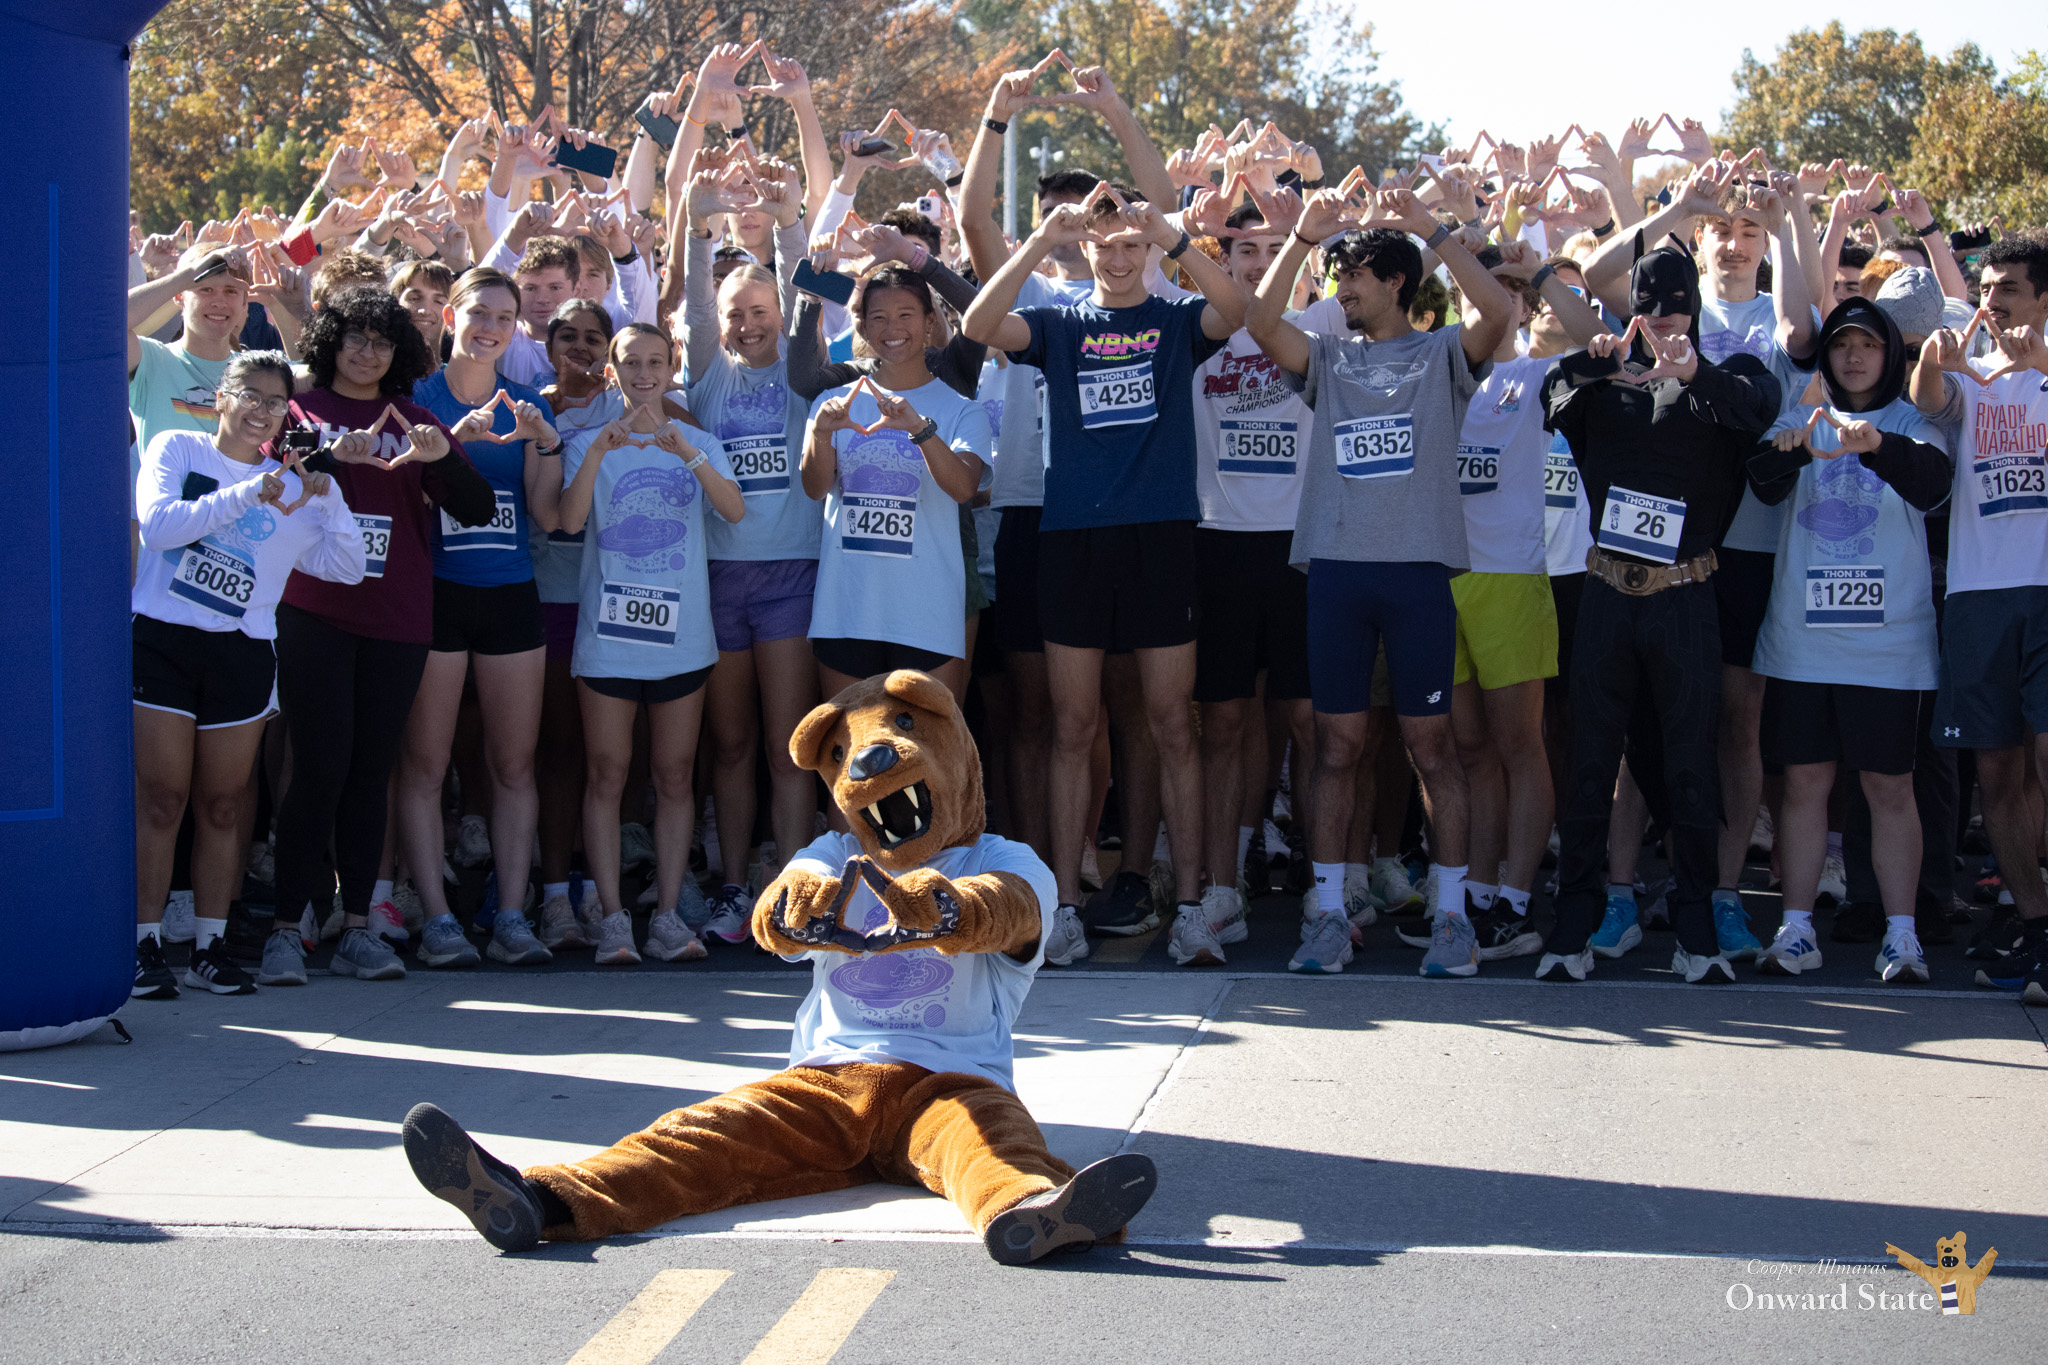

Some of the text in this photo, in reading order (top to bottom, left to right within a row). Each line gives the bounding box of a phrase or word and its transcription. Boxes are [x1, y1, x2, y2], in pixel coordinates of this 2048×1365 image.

[1080, 328, 1160, 355] NBNO
[1094, 369, 1140, 383] THON 5K
[1098, 378, 1154, 406] 4259
[1225, 389, 1295, 415] CHAMPIONSHIP
[1238, 382, 1286, 404] STATE INDO
[1237, 421, 1282, 431] THON 5K
[1351, 420, 1397, 432] THON 5K
[1976, 402, 2027, 430] RIYADH
[730, 439, 772, 451] THON 5K
[1237, 433, 1296, 458] 5503
[1354, 430, 1412, 459] 6352
[1975, 423, 2047, 455] MARATHO
[732, 450, 787, 477] 2985
[1457, 456, 1498, 479] 766
[1556, 458, 1569, 466] 5K
[1988, 456, 2030, 469] THON 5K
[619, 470, 670, 489] DREAM BEYOND
[628, 478, 675, 489] THE DISTANCE
[1544, 468, 1578, 493] 279
[1993, 469, 2046, 495] 1623
[858, 498, 901, 509] THON 5K
[1624, 494, 1670, 512] THON 5K
[363, 519, 376, 528] 5K
[857, 510, 913, 538] 4263
[1633, 511, 1666, 538] 26
[362, 531, 388, 556] 33
[204, 547, 247, 573] THON 5K
[194, 561, 255, 603] 6083
[1823, 570, 1868, 578] THON 5K
[620, 586, 664, 600] THON 5K
[1824, 582, 1883, 606] 1229
[625, 600, 670, 627] 990
[862, 1015, 884, 1029] THON
[911, 1021, 922, 1029] 5K
